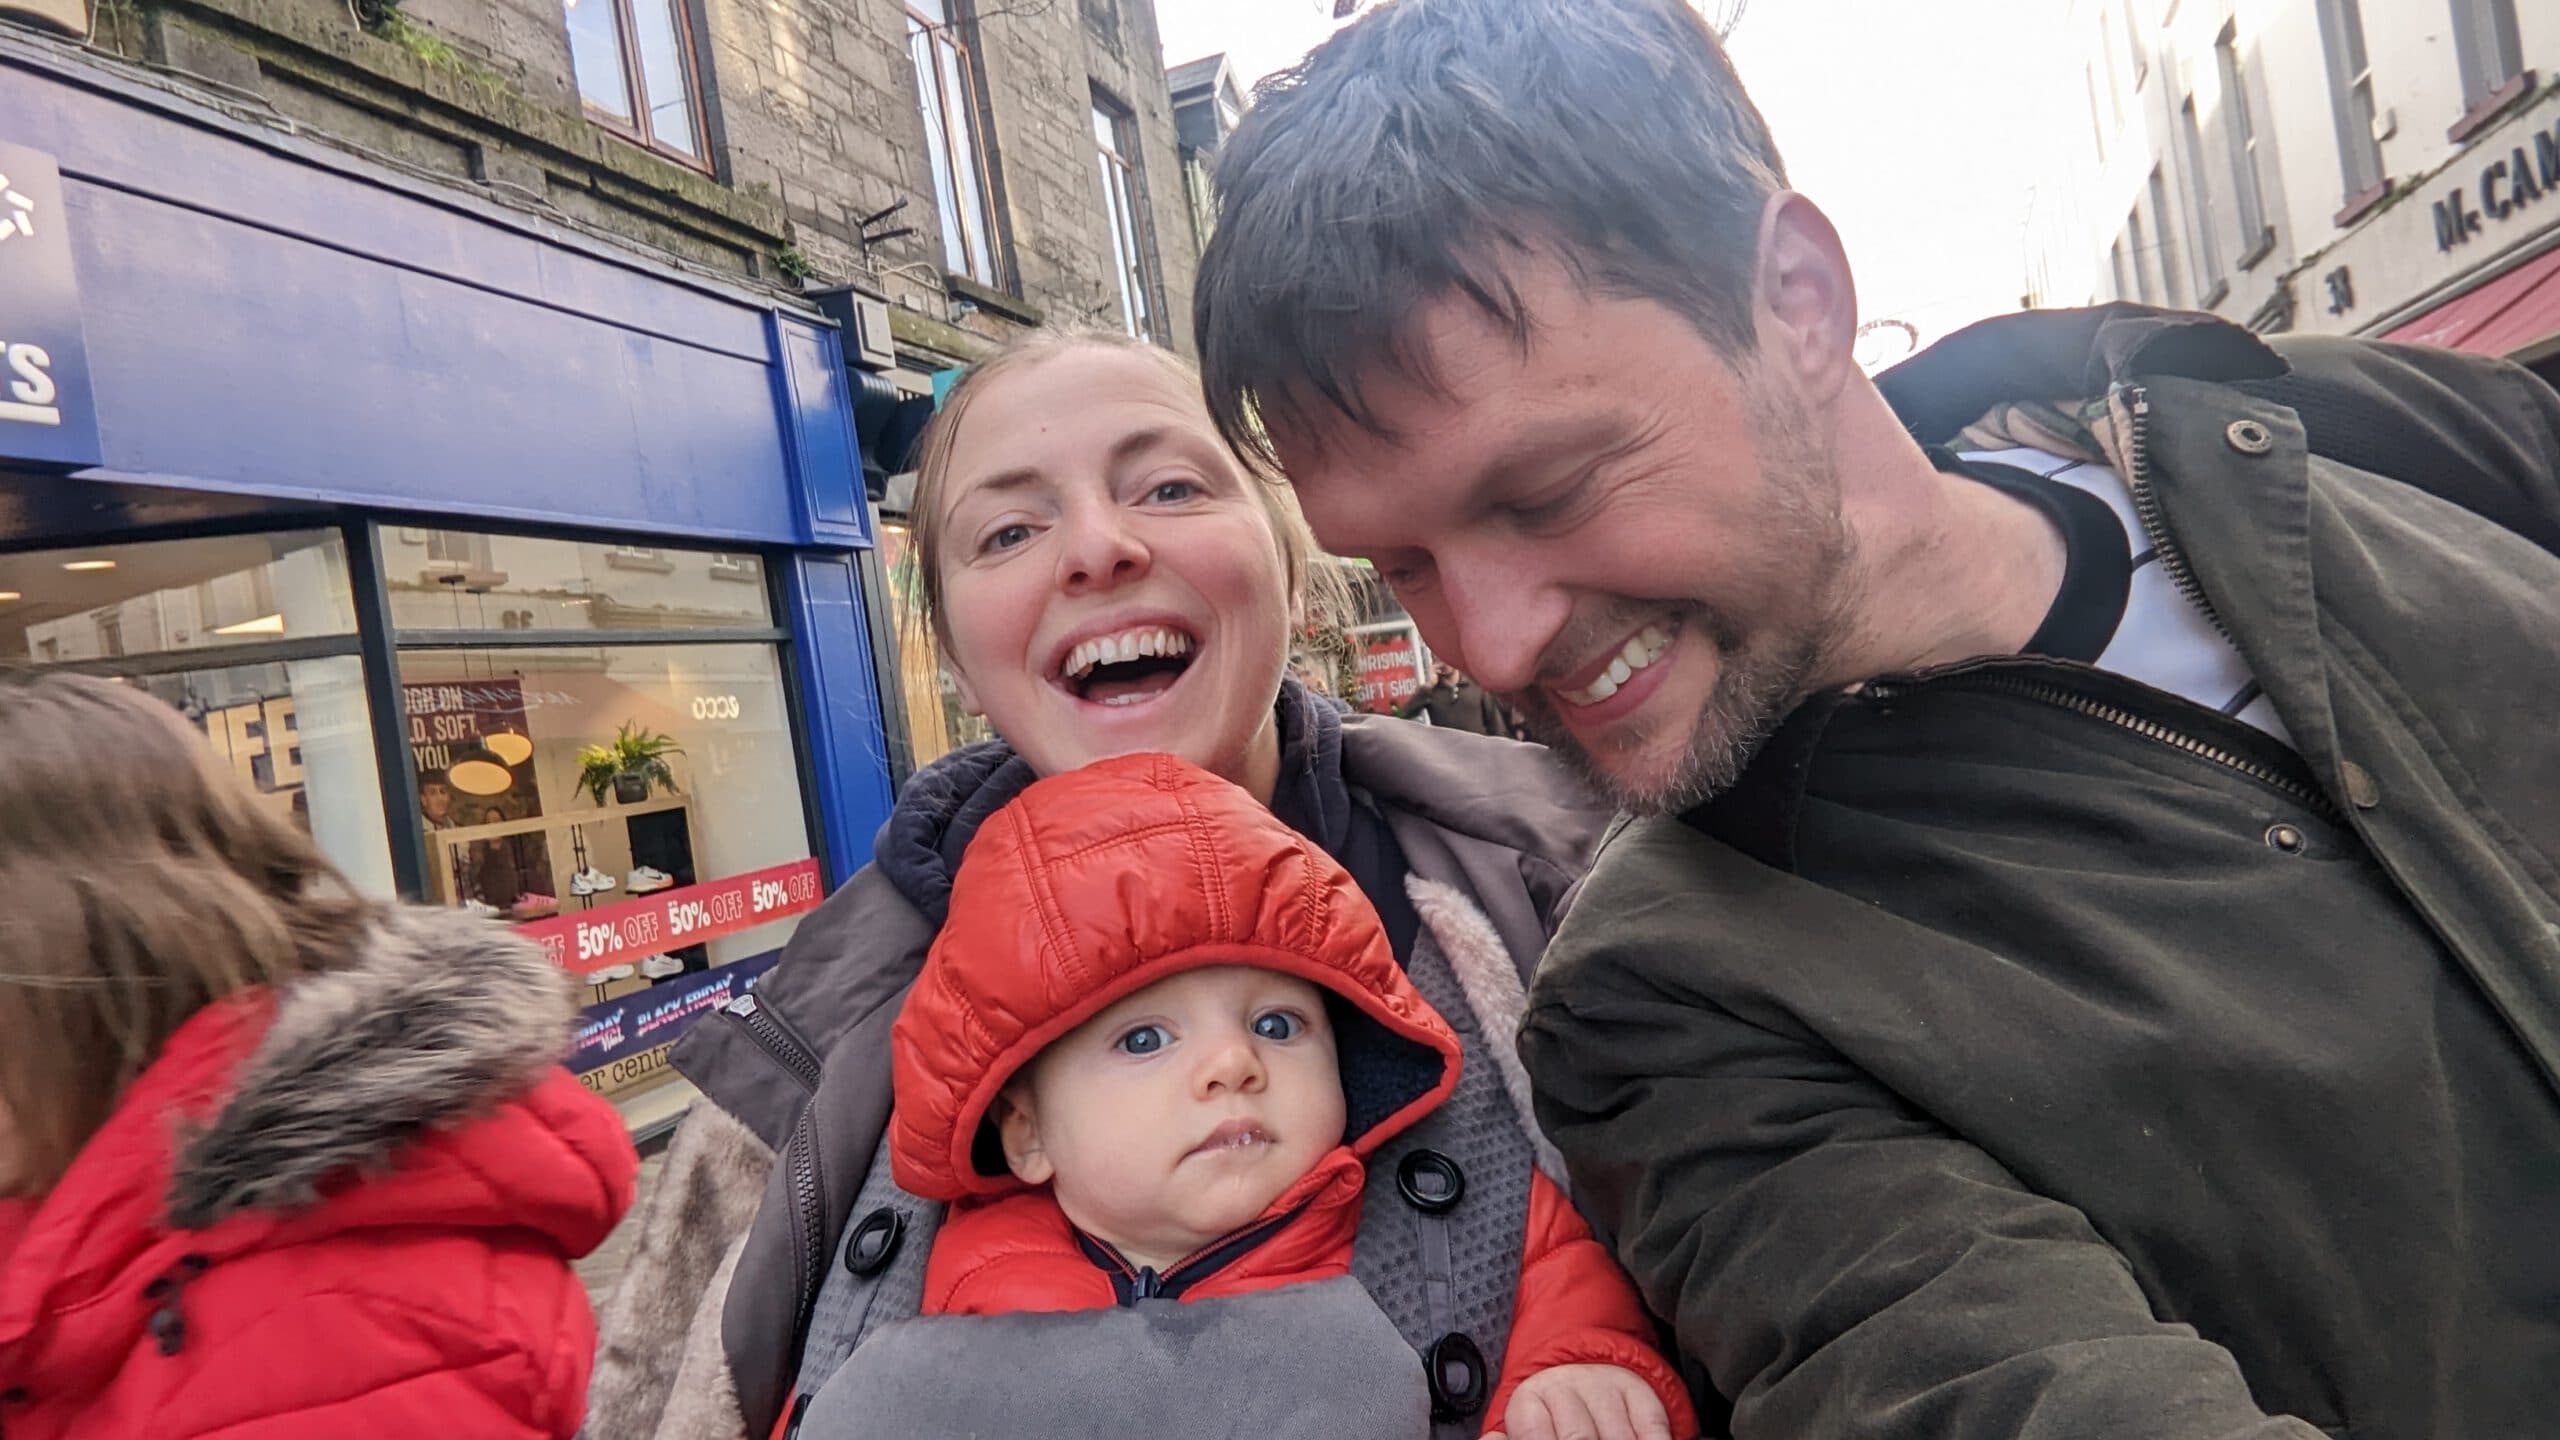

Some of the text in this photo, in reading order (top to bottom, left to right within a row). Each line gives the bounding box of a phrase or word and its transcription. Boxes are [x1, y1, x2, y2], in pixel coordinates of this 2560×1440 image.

[0, 340, 56, 404] S
[438, 685, 464, 712] ON
[412, 744, 450, 773] YOU
[577, 922, 623, 960] 50%
[623, 912, 659, 947] OFF
[668, 900, 711, 935] 50%
[711, 889, 743, 924] OFF
[752, 879, 788, 913] 50%
[788, 871, 816, 904] OFF
[685, 973, 734, 1007] FRIDAY
